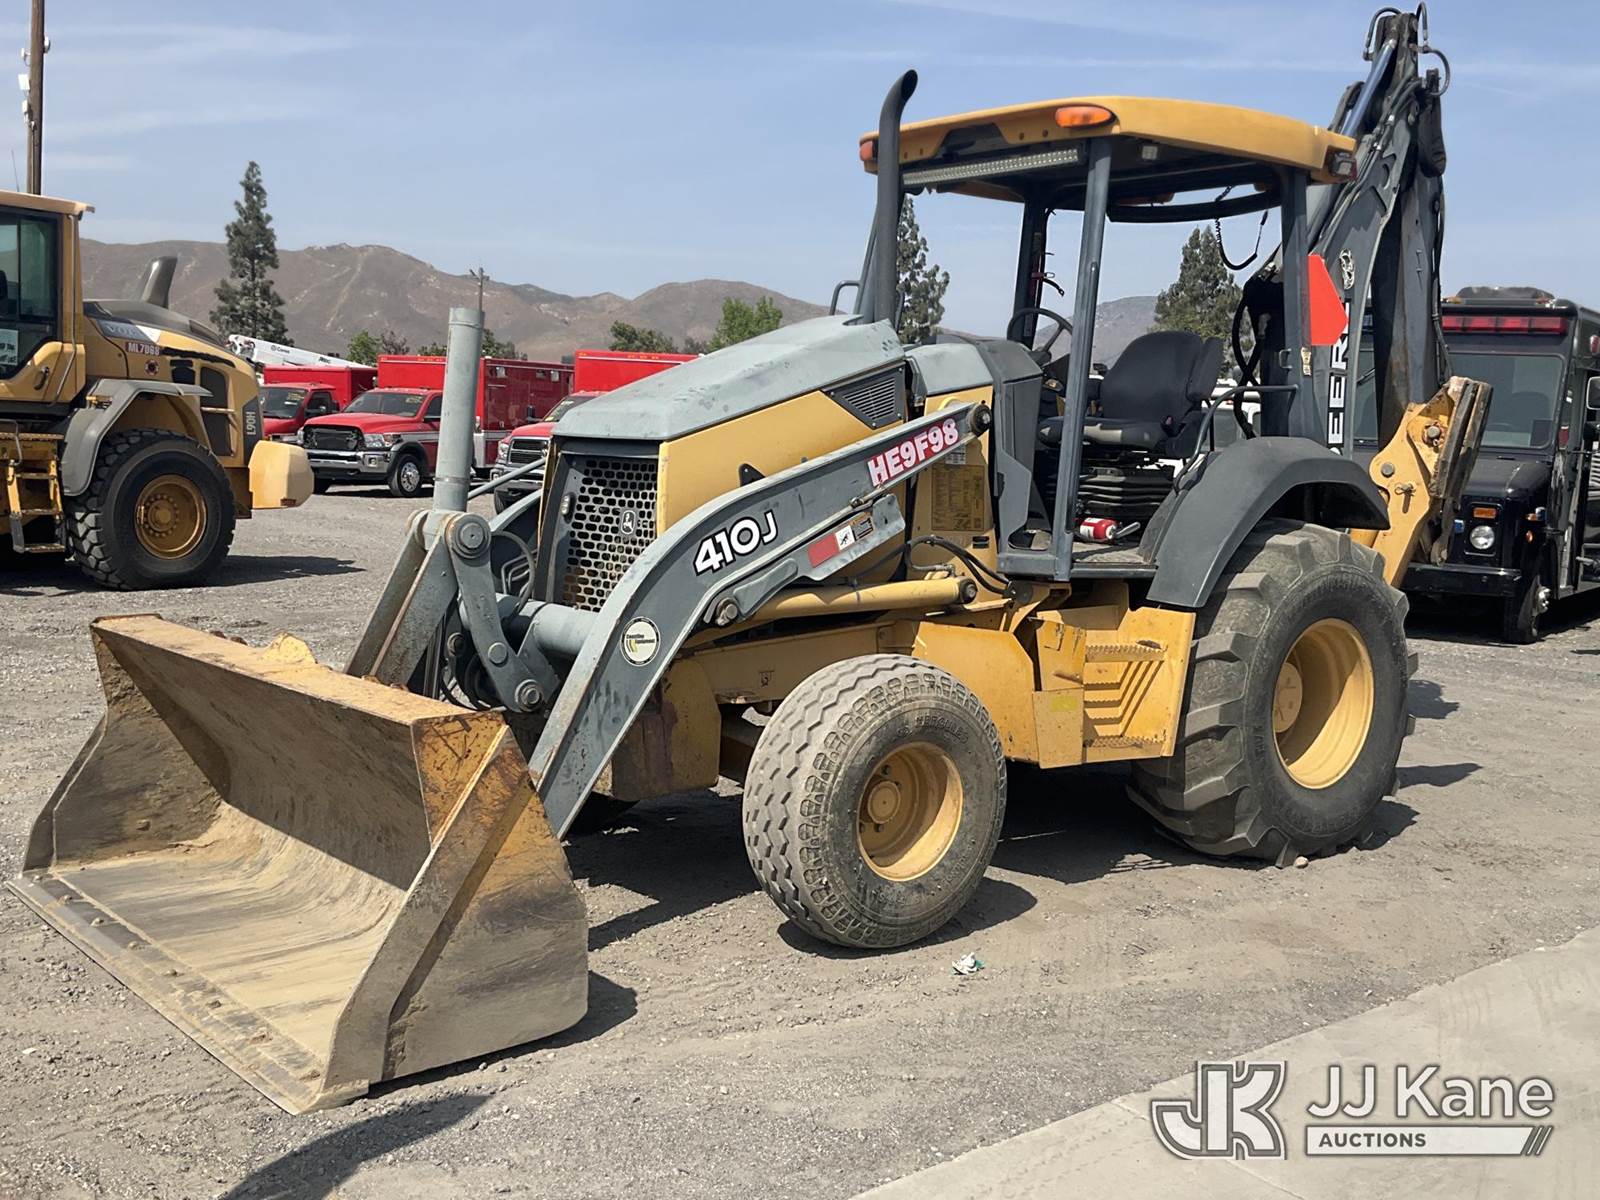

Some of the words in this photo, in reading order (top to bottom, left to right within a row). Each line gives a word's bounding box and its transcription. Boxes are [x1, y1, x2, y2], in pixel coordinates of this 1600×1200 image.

[1328, 301, 1350, 454] EER
[245, 411, 256, 435] L90H
[867, 418, 960, 487] HE9F98
[693, 509, 778, 576] 410J
